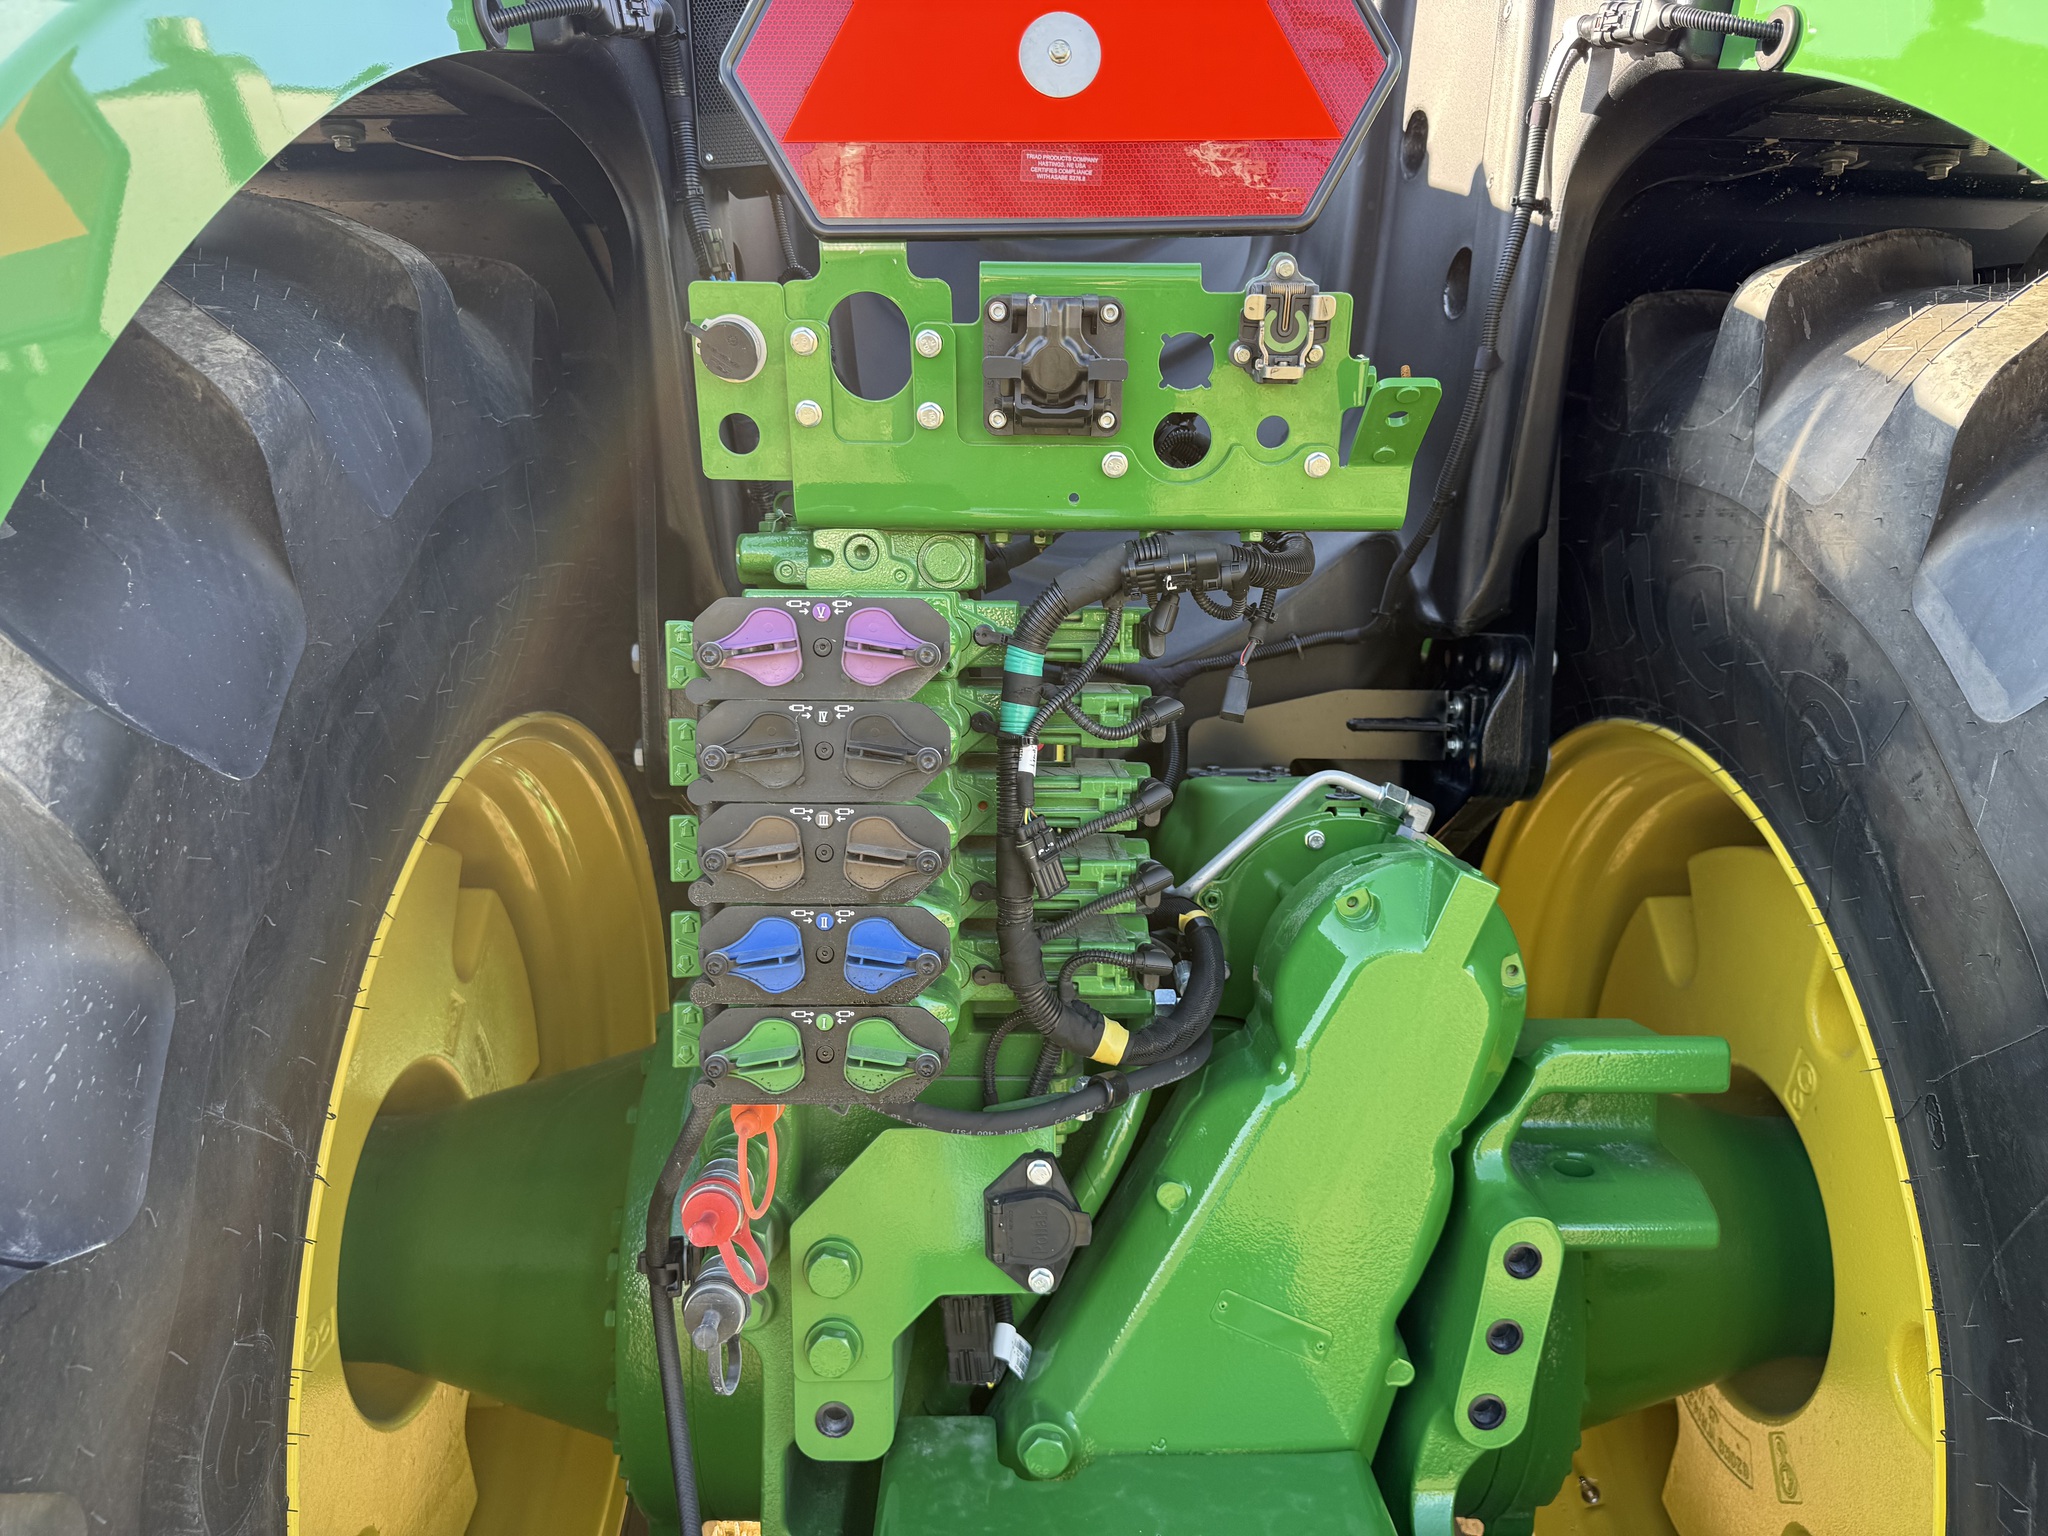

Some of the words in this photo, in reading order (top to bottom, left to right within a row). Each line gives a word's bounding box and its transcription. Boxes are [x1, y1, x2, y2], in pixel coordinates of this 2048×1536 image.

[1043, 154, 1072, 162] PRODUCTS
[1030, 166, 1058, 174] CERTIFIES
[1059, 168, 1093, 176] COMPLIANCE
[816, 606, 826, 619] V
[818, 710, 828, 723] IV
[818, 814, 829, 826] III
[820, 916, 828, 928] II
